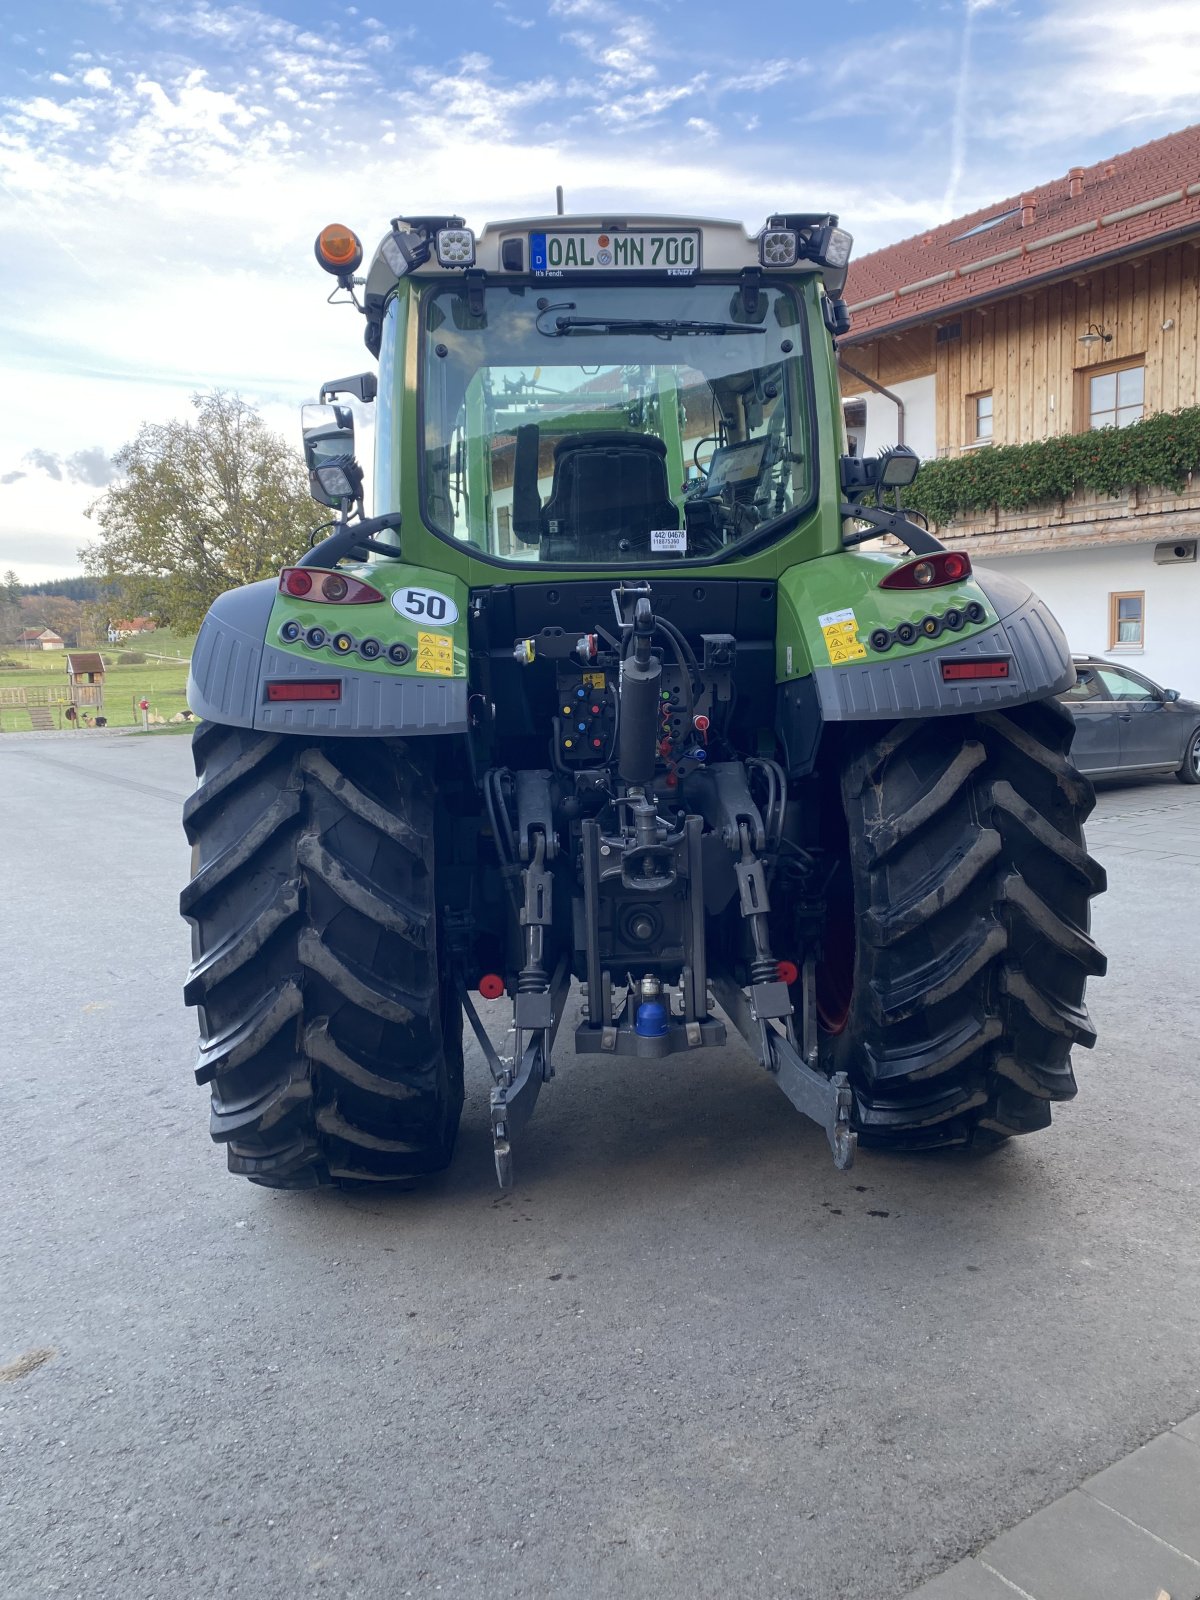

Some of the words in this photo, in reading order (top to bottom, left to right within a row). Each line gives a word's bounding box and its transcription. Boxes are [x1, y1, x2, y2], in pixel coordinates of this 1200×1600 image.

[536, 255, 542, 264] D
[548, 237, 595, 266] OAL
[614, 237, 644, 266] MN
[650, 236, 695, 265] 700
[535, 269, 544, 277] It's
[545, 269, 564, 277] Fendt.
[404, 590, 446, 620] 50
